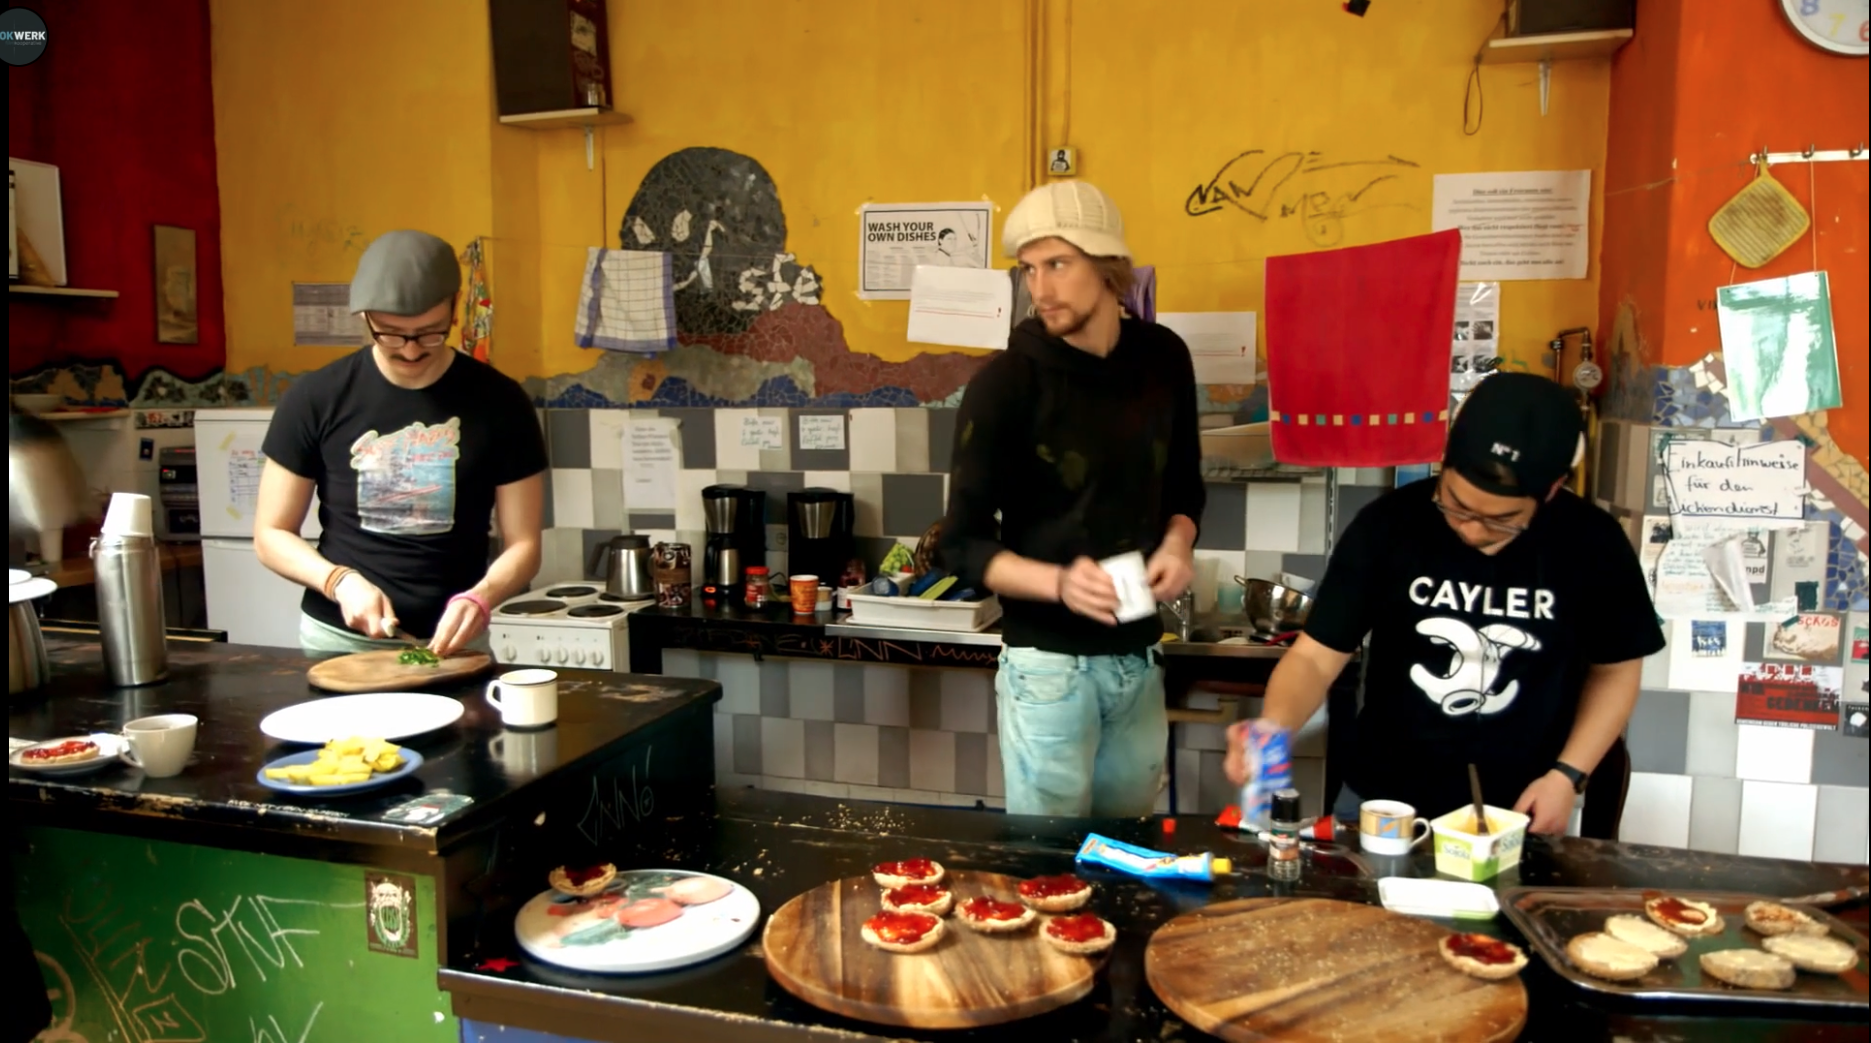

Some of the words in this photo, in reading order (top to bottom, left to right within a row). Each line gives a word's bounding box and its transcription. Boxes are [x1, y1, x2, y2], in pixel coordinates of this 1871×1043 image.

[1800, 0, 1820, 16] 8
[1829, 13, 1845, 37] 7
[868, 222, 900, 232] WASH
[903, 222, 934, 232] YOUR
[867, 233, 895, 242] OWN
[897, 232, 937, 242] DISHES
[1684, 474, 1711, 493] für
[1719, 478, 1754, 492] den
[1409, 576, 1555, 620] CAYLER
